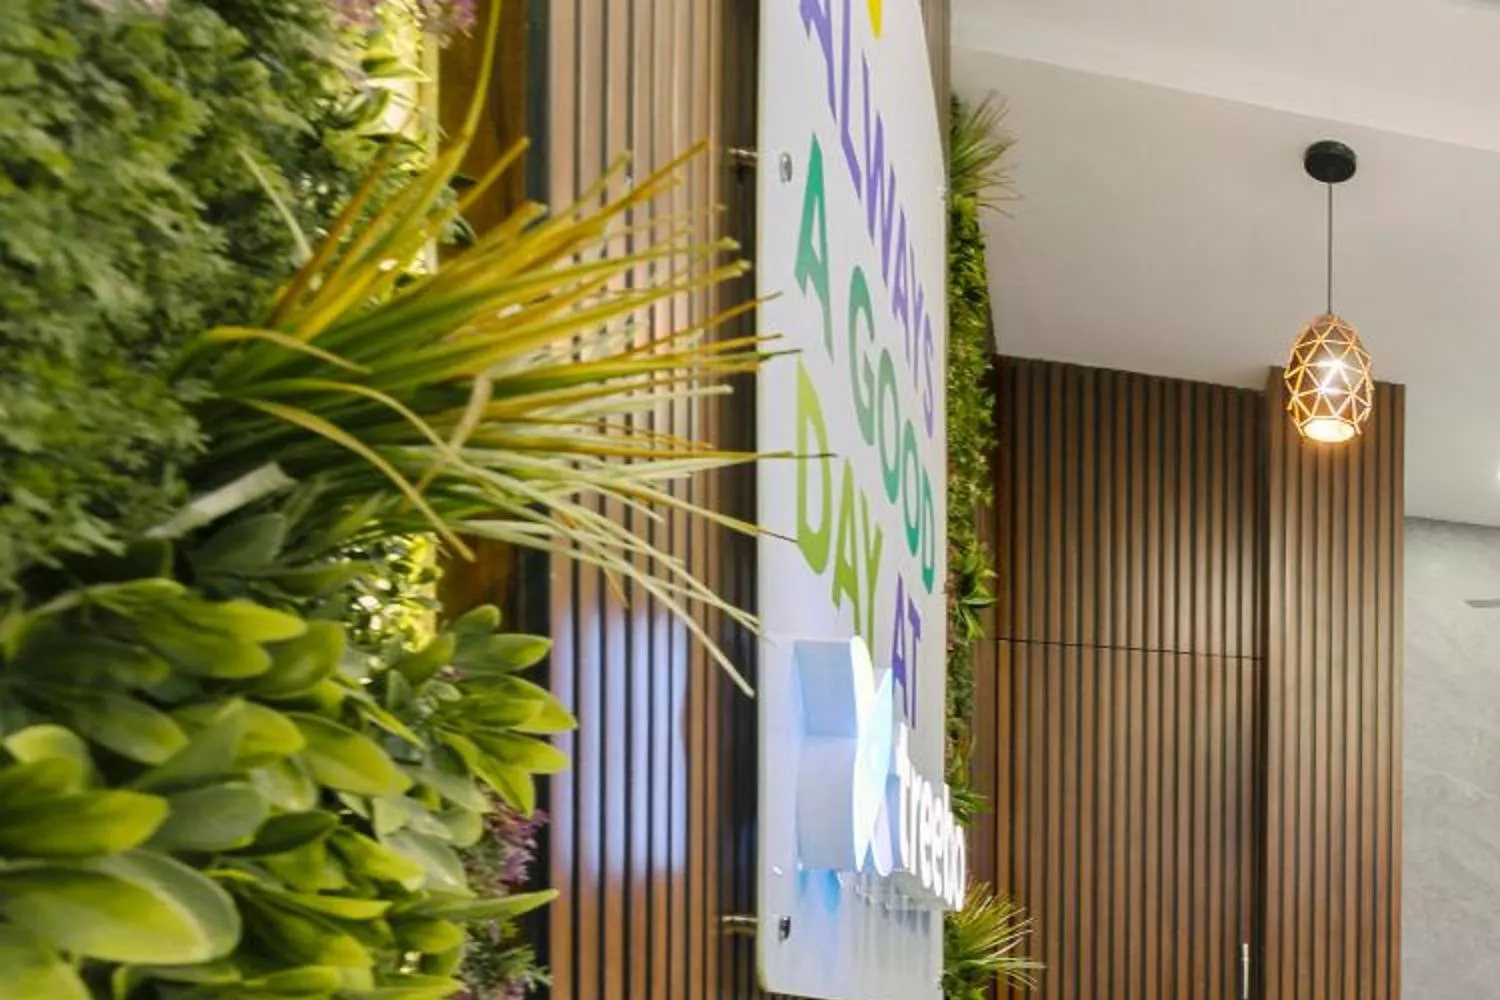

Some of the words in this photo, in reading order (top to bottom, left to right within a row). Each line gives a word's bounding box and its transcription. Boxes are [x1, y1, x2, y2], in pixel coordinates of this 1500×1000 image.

[795, 132, 834, 364] A
[848, 265, 936, 594] GOOD
[796, 354, 884, 670] DAY
[891, 570, 921, 728] AT
[896, 722, 966, 912] treebo
